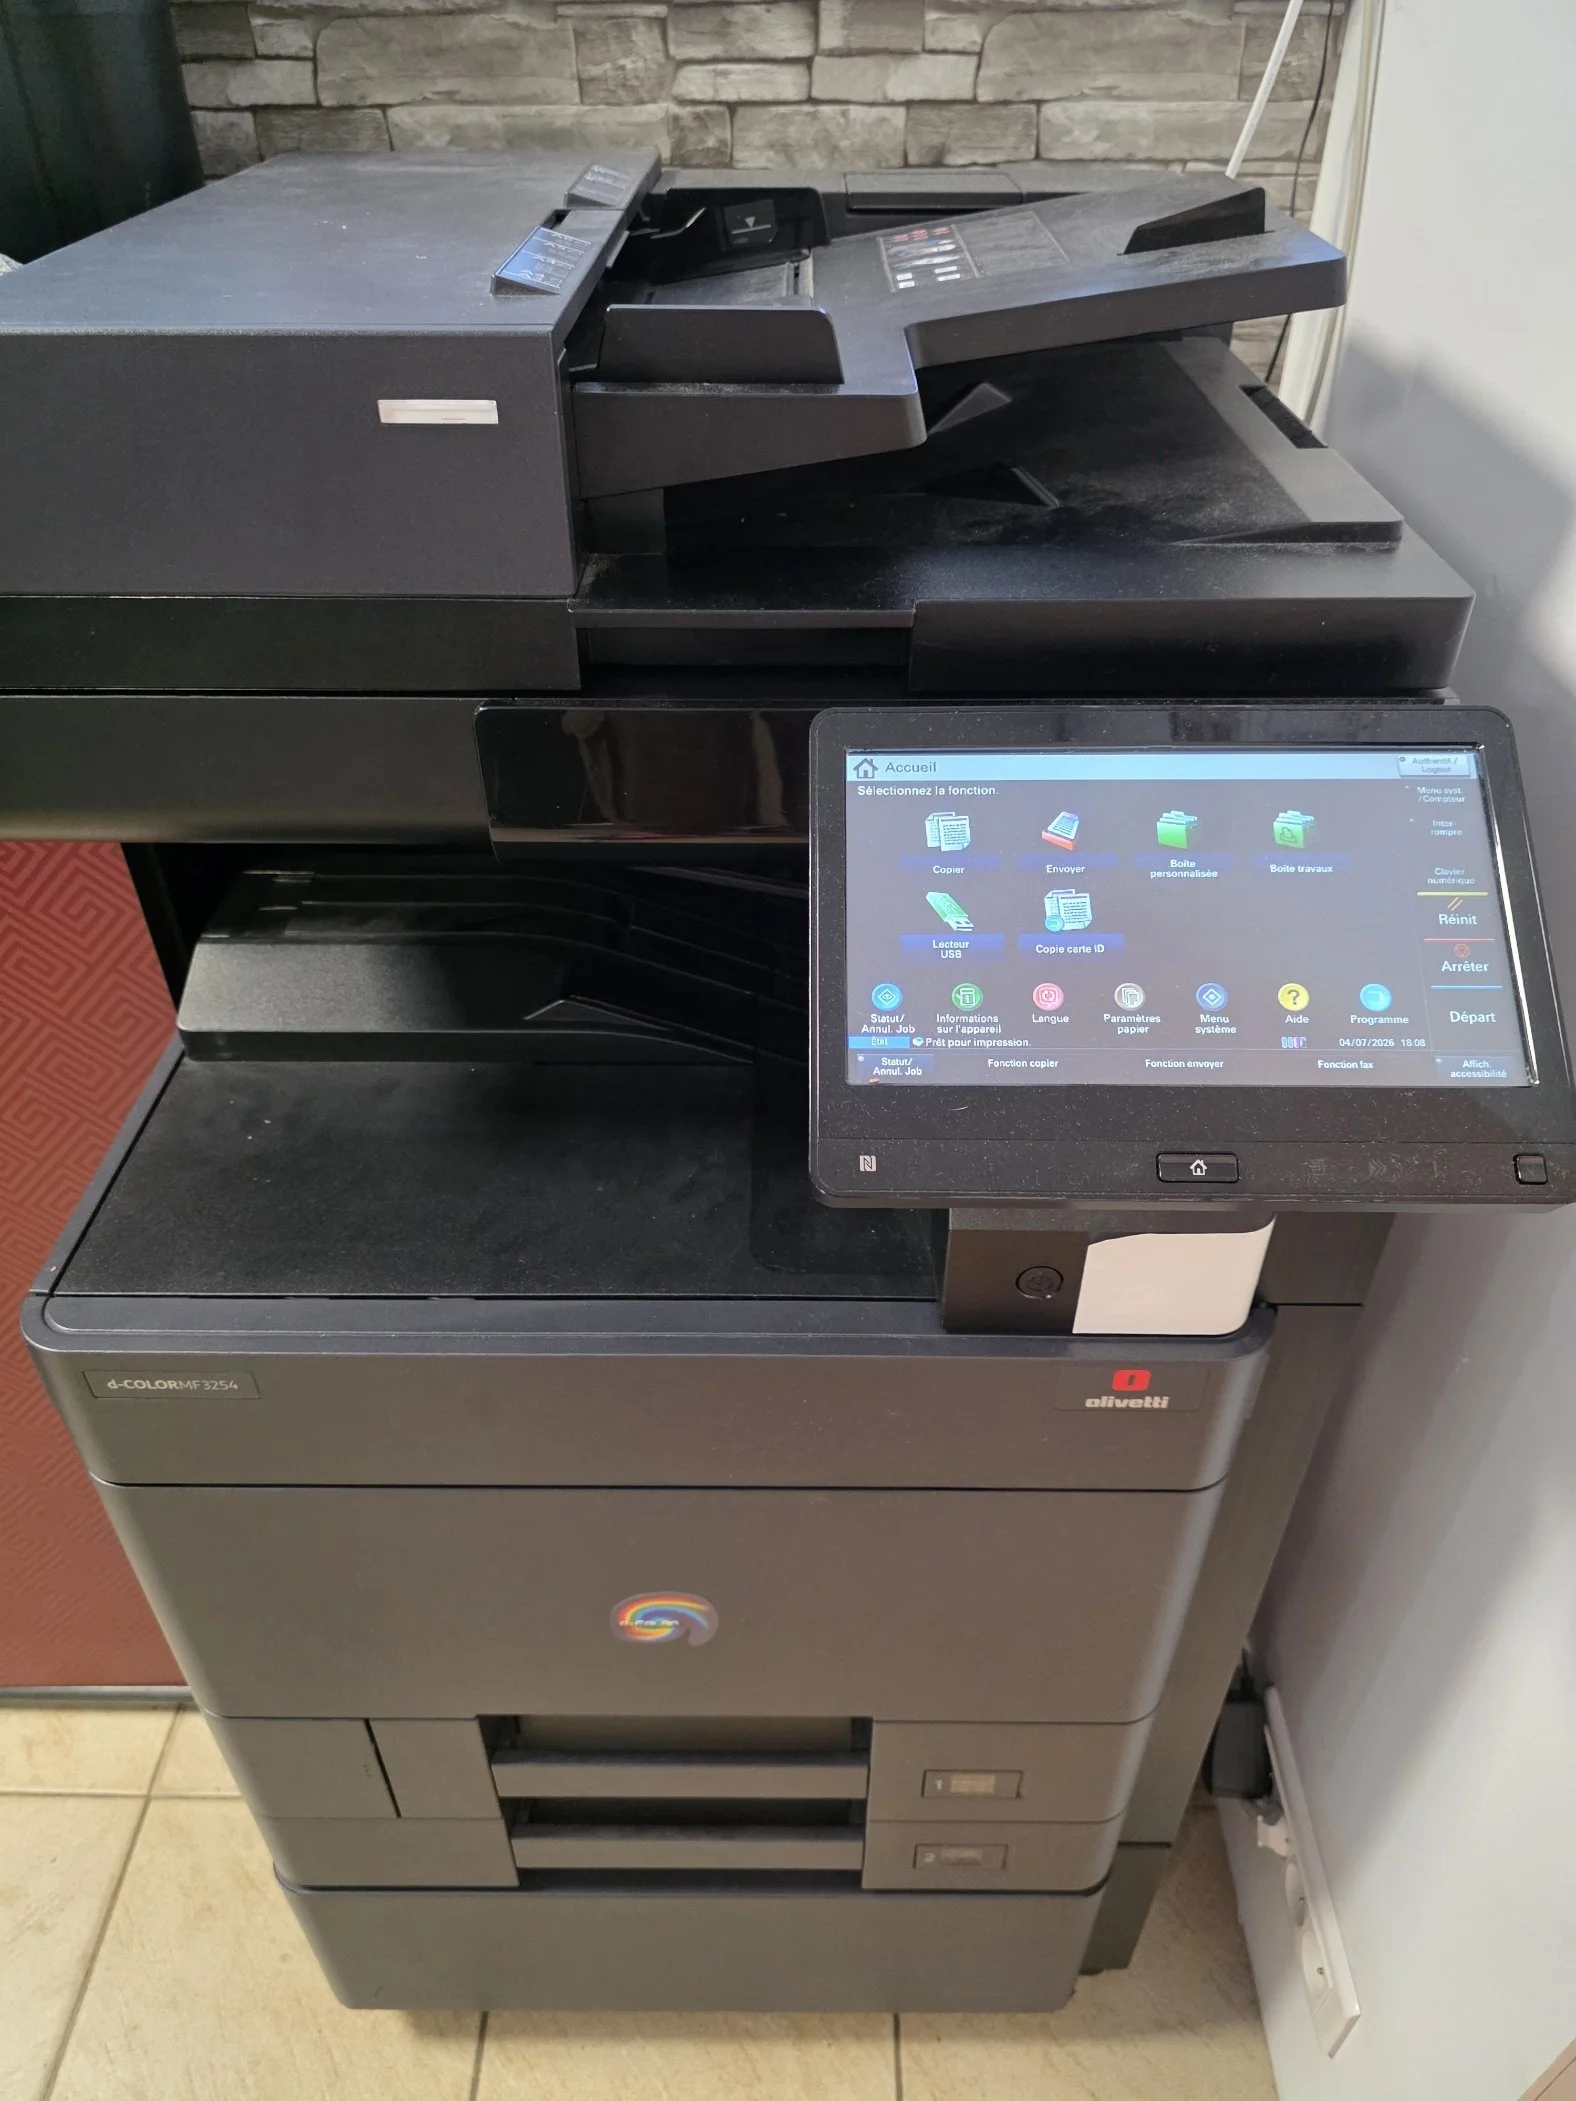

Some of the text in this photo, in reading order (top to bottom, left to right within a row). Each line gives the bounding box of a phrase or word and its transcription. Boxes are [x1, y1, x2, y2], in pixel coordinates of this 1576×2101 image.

[885, 761, 937, 774] Accueil
[857, 785, 1000, 797] Sélectionnez la fonction.
[932, 864, 965, 876] Copier
[1046, 863, 1086, 876] Envoyer
[1170, 859, 1196, 869] Boîte
[1269, 862, 1334, 874] Boîte travaux
[1150, 869, 1219, 880] personnalisée
[1434, 867, 1465, 876] Clavier
[1427, 876, 1476, 886] numérique
[1438, 913, 1478, 925] Réinit
[932, 939, 969, 950] Lecteur
[1035, 943, 1105, 955] Copie carte ID
[940, 950, 962, 960] USB
[1441, 960, 1489, 972] Arrêter
[870, 1013, 905, 1024] Statut/
[936, 1013, 999, 1024] Informations
[1032, 1013, 1069, 1025] Langue
[1103, 1013, 1161, 1025] Paramètres
[1200, 1014, 1229, 1024] Menu
[1285, 1013, 1309, 1024] Aide
[1350, 1013, 1409, 1025] Programme
[1449, 1010, 1496, 1024] Départ
[861, 1024, 916, 1035] Annul. Job
[936, 1023, 1002, 1035] sur l'appareil
[1117, 1024, 1150, 1036] papier
[1195, 1024, 1237, 1035] système
[925, 1036, 1032, 1048] Prêt pour impression.
[1339, 1038, 1395, 1047] 04/07/2026
[881, 1057, 913, 1067] Statut/
[987, 1058, 1059, 1070] Fonction copier
[1145, 1059, 1224, 1071] Fonction envoyer
[1317, 1060, 1374, 1069] Fonction fax
[873, 1066, 923, 1076] Annul. Job
[1450, 1070, 1508, 1078] accessibilité
[1084, 1396, 1169, 1408] olivetti
